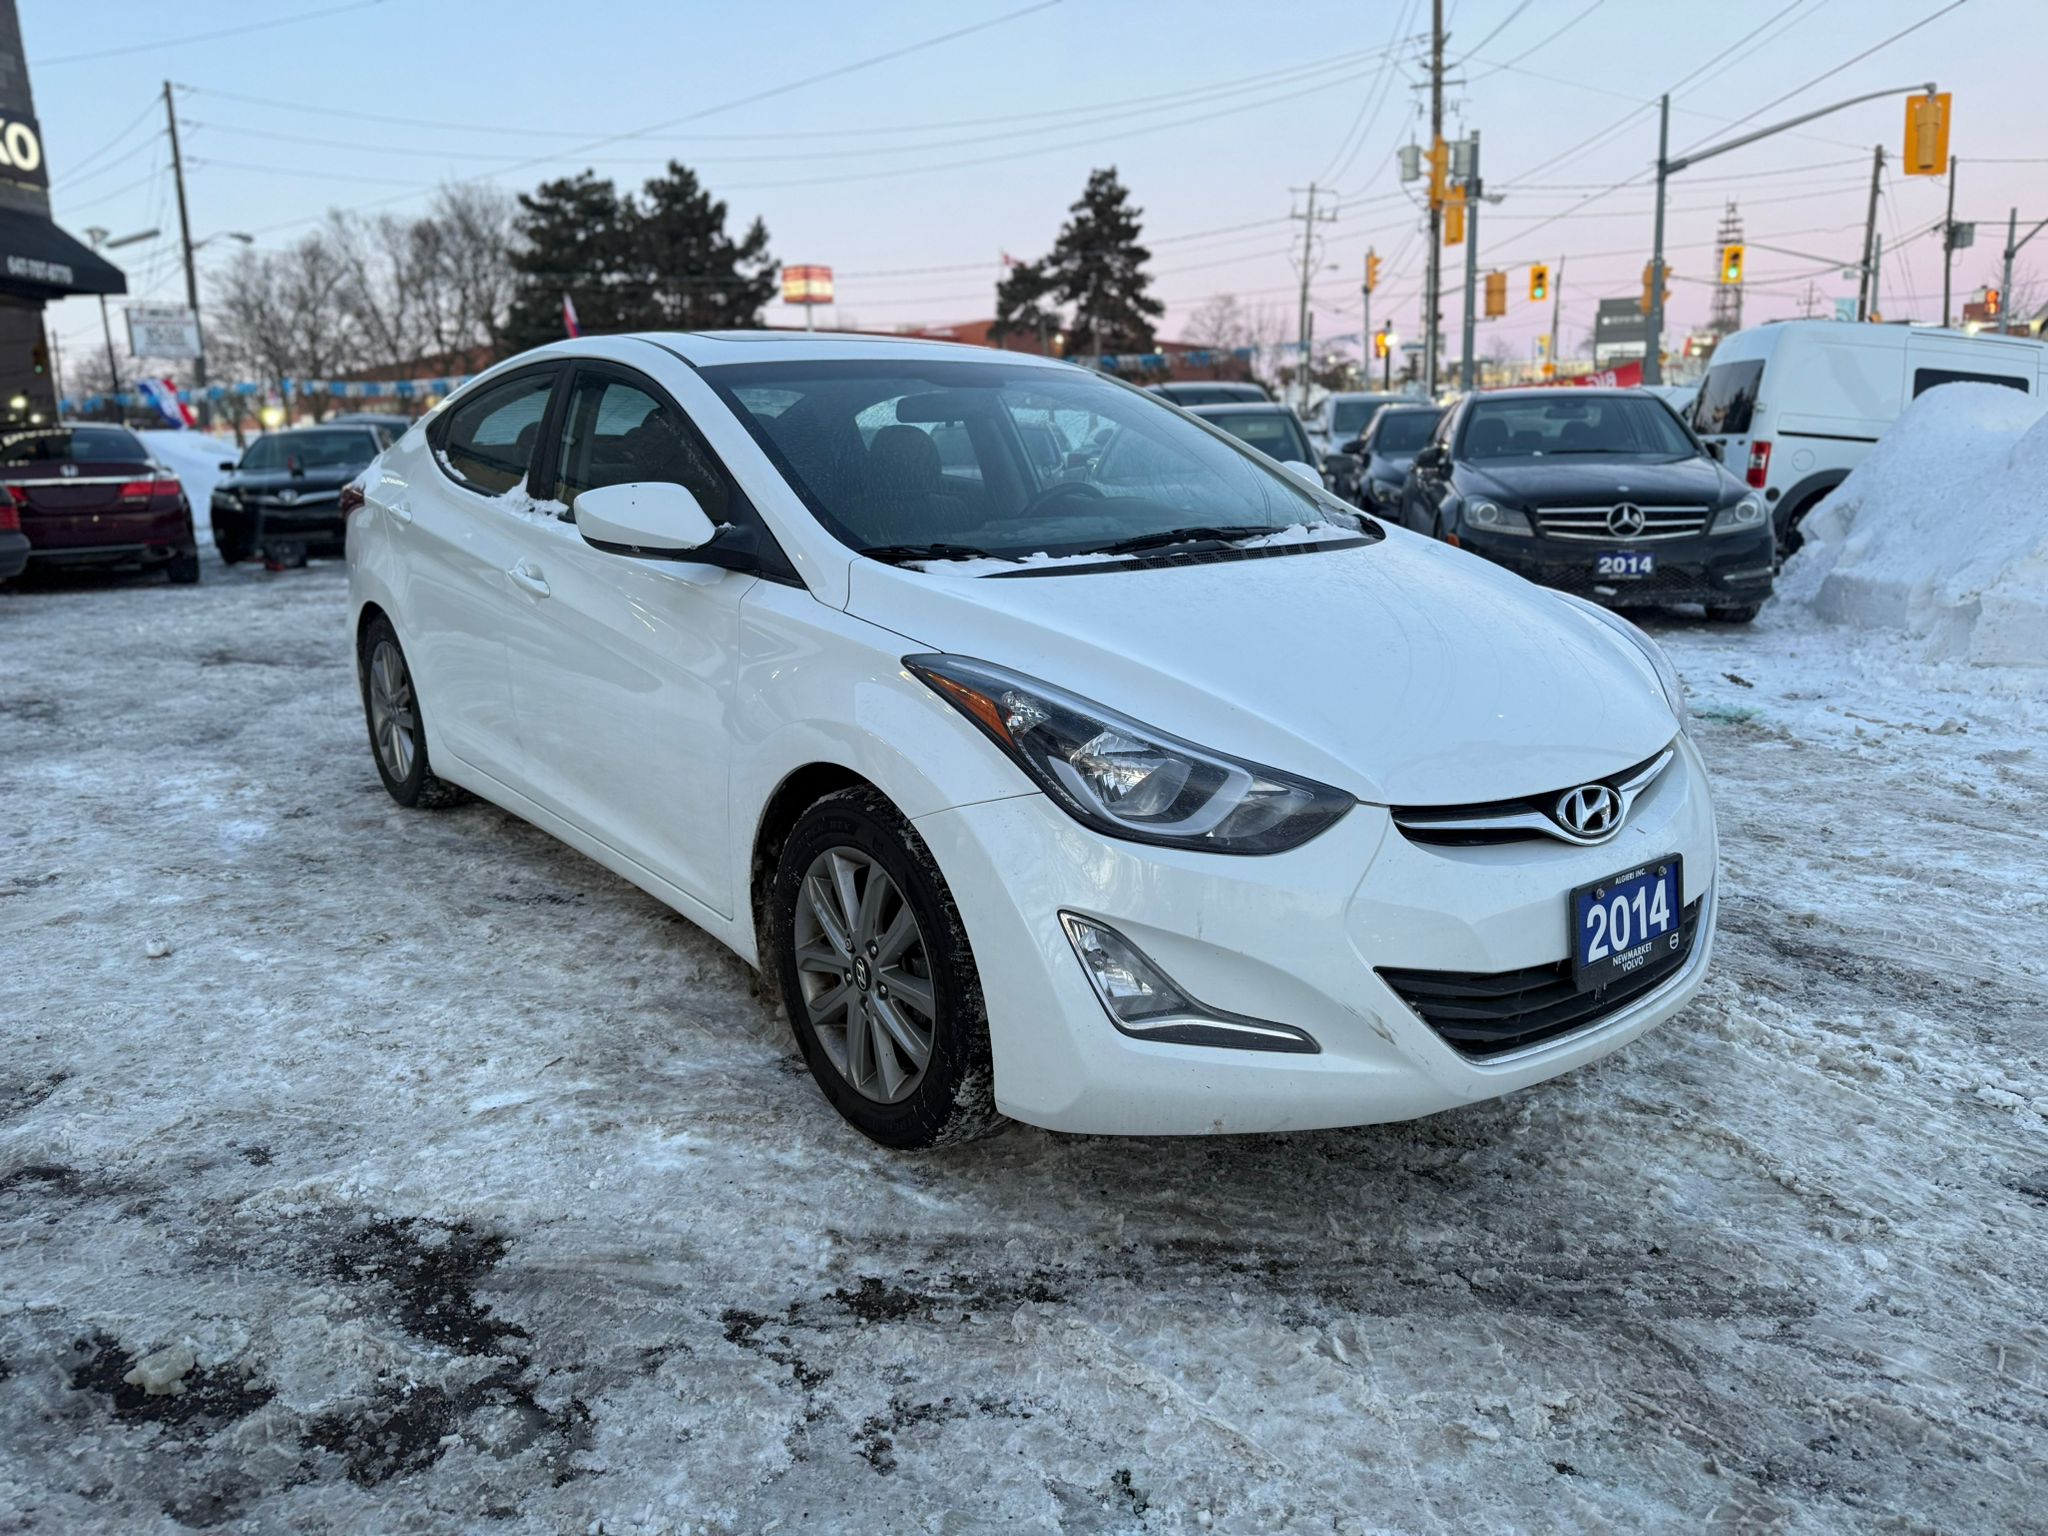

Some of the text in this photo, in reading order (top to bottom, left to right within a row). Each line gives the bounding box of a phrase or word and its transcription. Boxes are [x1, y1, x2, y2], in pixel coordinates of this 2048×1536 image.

[1598, 556, 1653, 574] 2014
[1587, 879, 1670, 963] 2014
[1612, 942, 1653, 967] NEWMARKET
[1622, 955, 1644, 972] VOLVO
